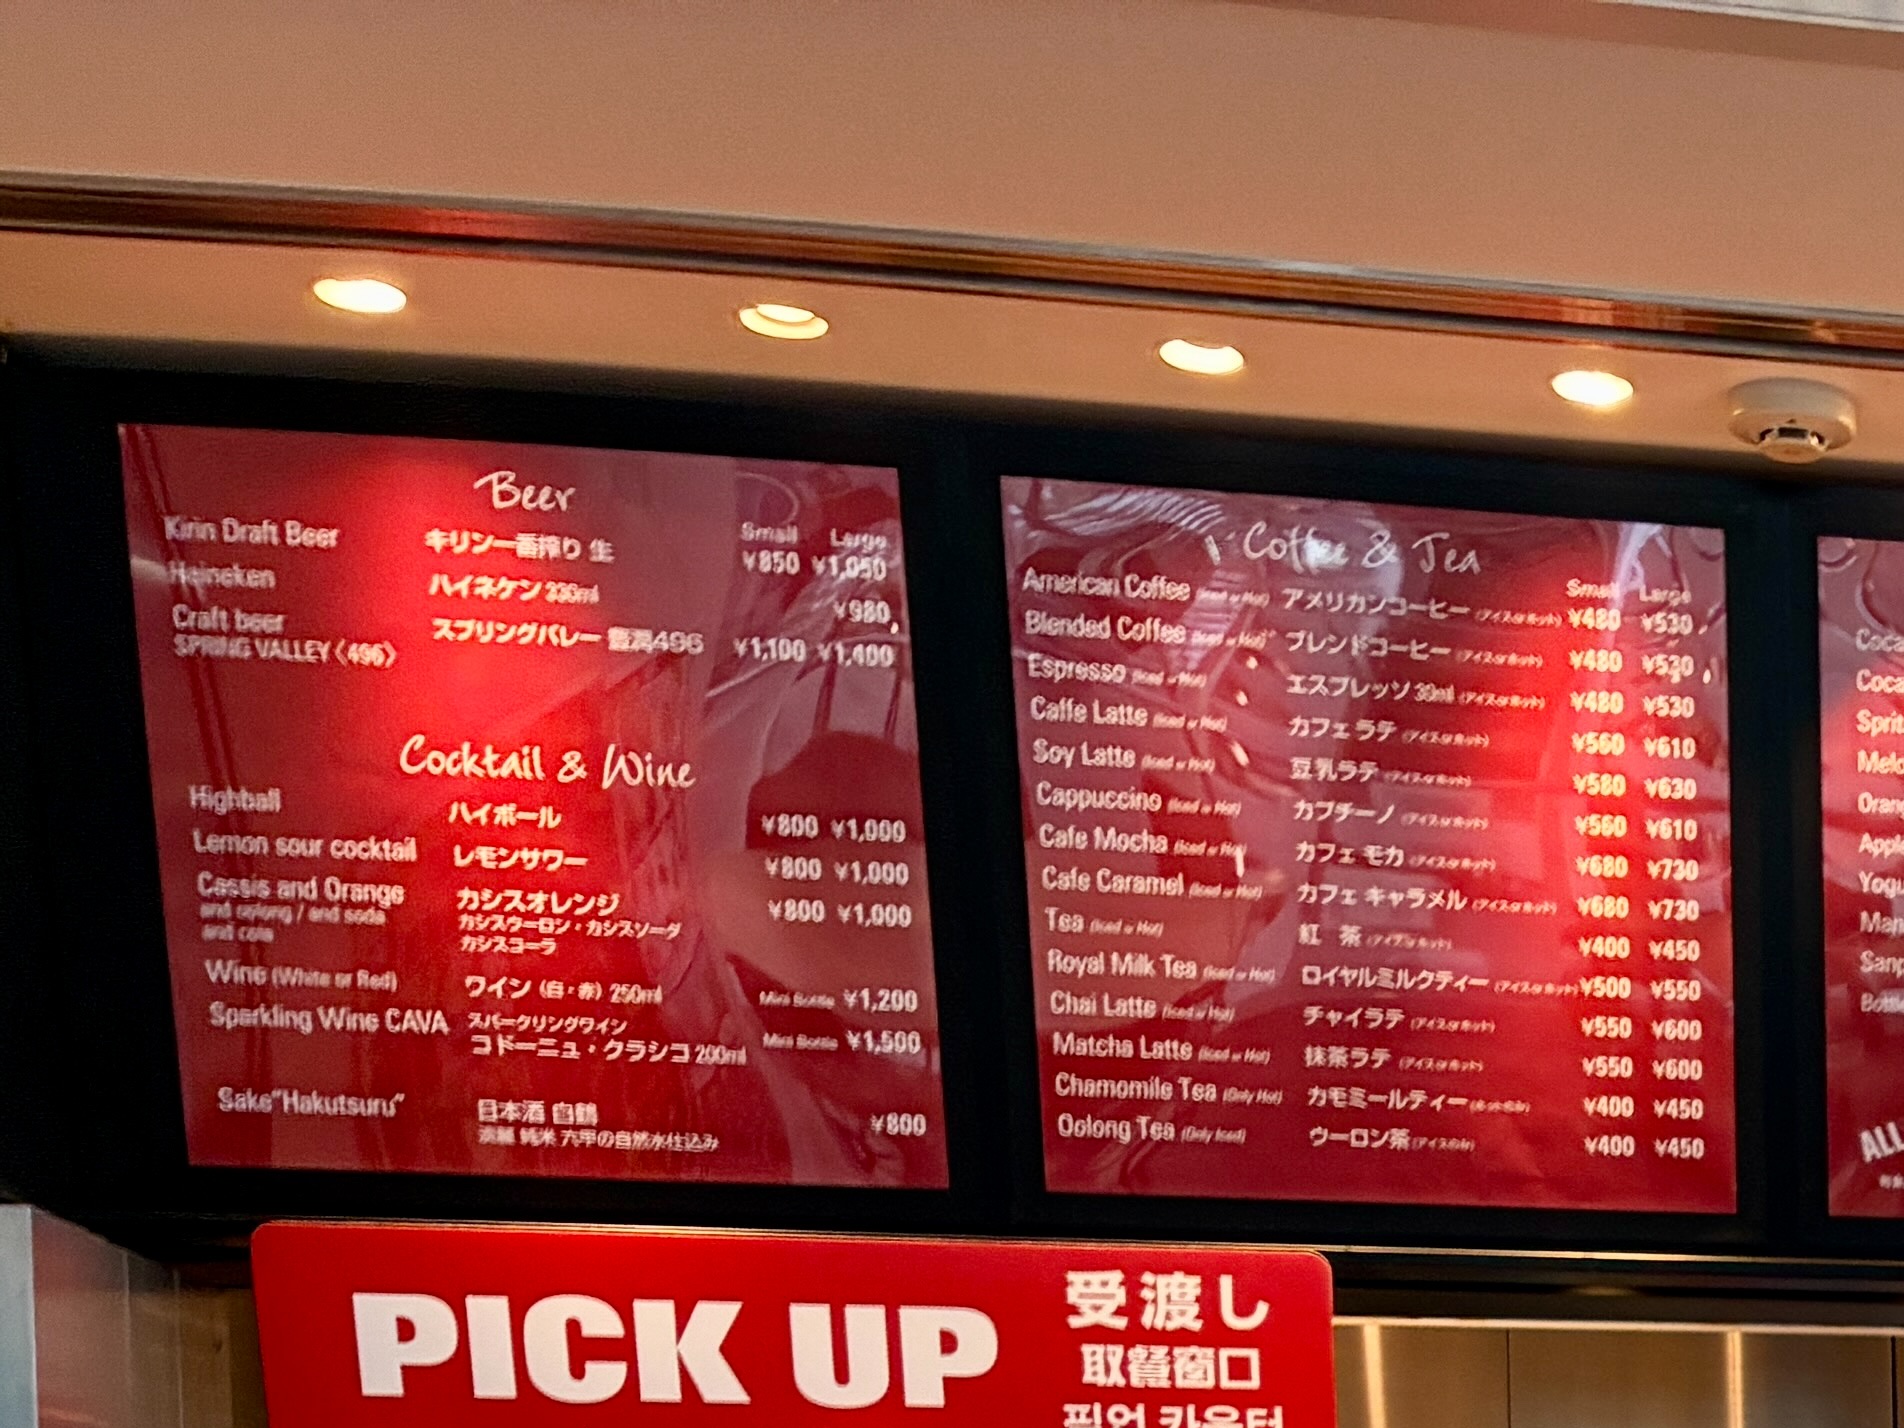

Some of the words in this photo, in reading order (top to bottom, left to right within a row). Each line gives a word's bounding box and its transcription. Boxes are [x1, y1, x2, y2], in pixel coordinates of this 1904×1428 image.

[474, 471, 575, 511] Beer
[1025, 609, 1111, 640] Blended
[1117, 616, 1186, 644] Coffee
[1028, 653, 1126, 683] Espresso
[400, 735, 544, 780] Cocktail
[557, 752, 586, 783] &
[602, 744, 695, 789] Wine
[1032, 738, 1075, 769] Soy
[1082, 742, 1136, 768] Latte
[1037, 781, 1162, 812] Cappuccino
[448, 803, 561, 829] ハイボール
[454, 845, 588, 870] レモンサワー
[1047, 949, 1104, 978] Royal
[1112, 952, 1155, 977] Milk
[1160, 954, 1197, 979] Tea
[843, 989, 918, 1013] ¥1,200
[209, 1001, 313, 1035] Sparkling
[317, 1006, 379, 1031] Wine
[385, 1008, 449, 1035] CAVA
[847, 1030, 921, 1054] ¥1,500
[1053, 1032, 1133, 1057] Matcha
[1140, 1035, 1192, 1061] Latte
[1055, 1072, 1172, 1100] Chamomile
[1178, 1077, 1216, 1101] Tea
[1058, 1113, 1130, 1143] Oolong
[1137, 1115, 1175, 1142] Tea
[1585, 1136, 1634, 1157] ¥400
[1655, 1138, 1704, 1159] ¥450
[1065, 1270, 1271, 1334] 受渡し
[352, 1292, 750, 1404] PICK
[789, 1303, 999, 1409] UP
